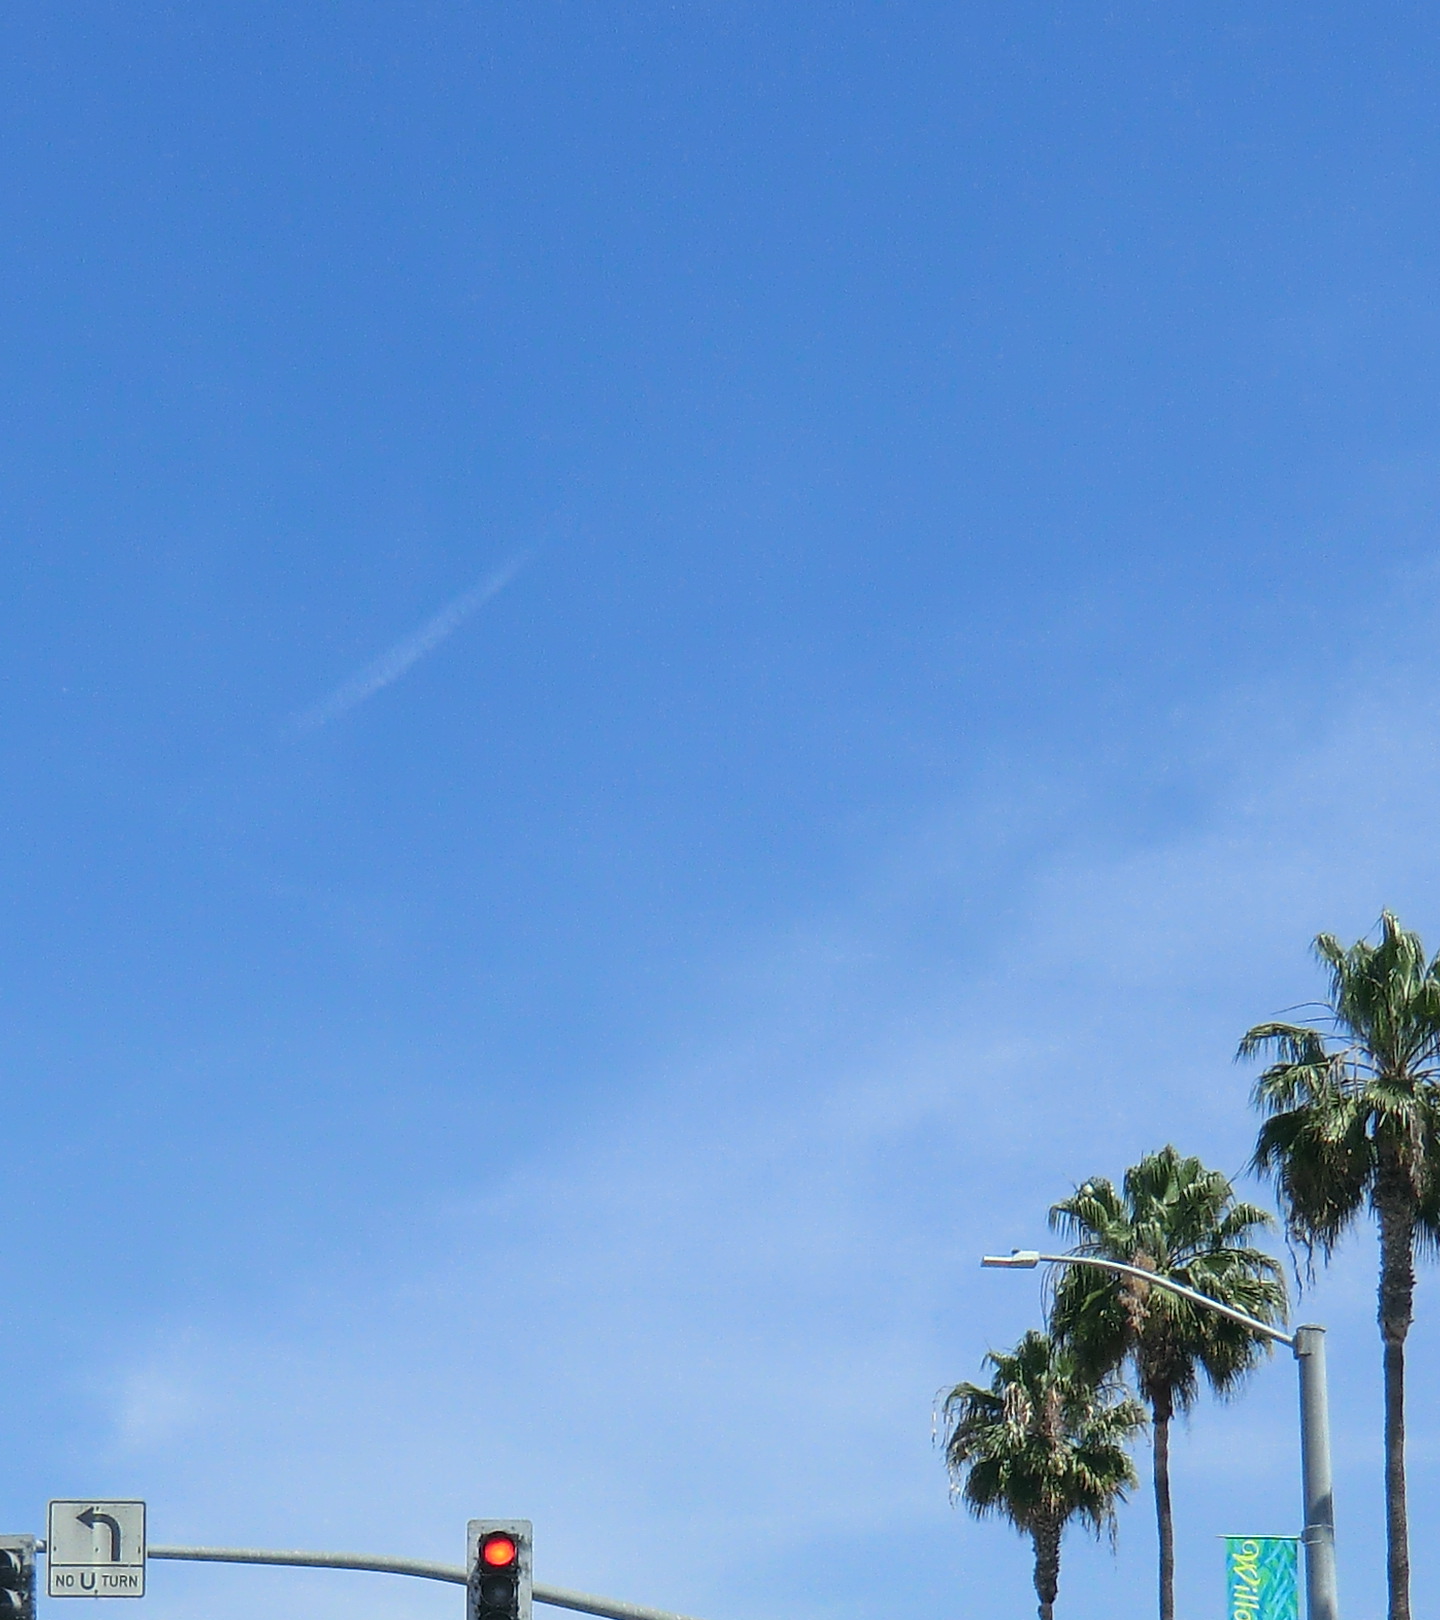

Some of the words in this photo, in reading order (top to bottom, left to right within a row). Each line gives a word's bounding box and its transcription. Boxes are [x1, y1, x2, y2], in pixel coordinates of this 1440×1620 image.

[55, 1574, 75, 1587] NO
[80, 1572, 96, 1590] U
[101, 1574, 138, 1588] TURN
